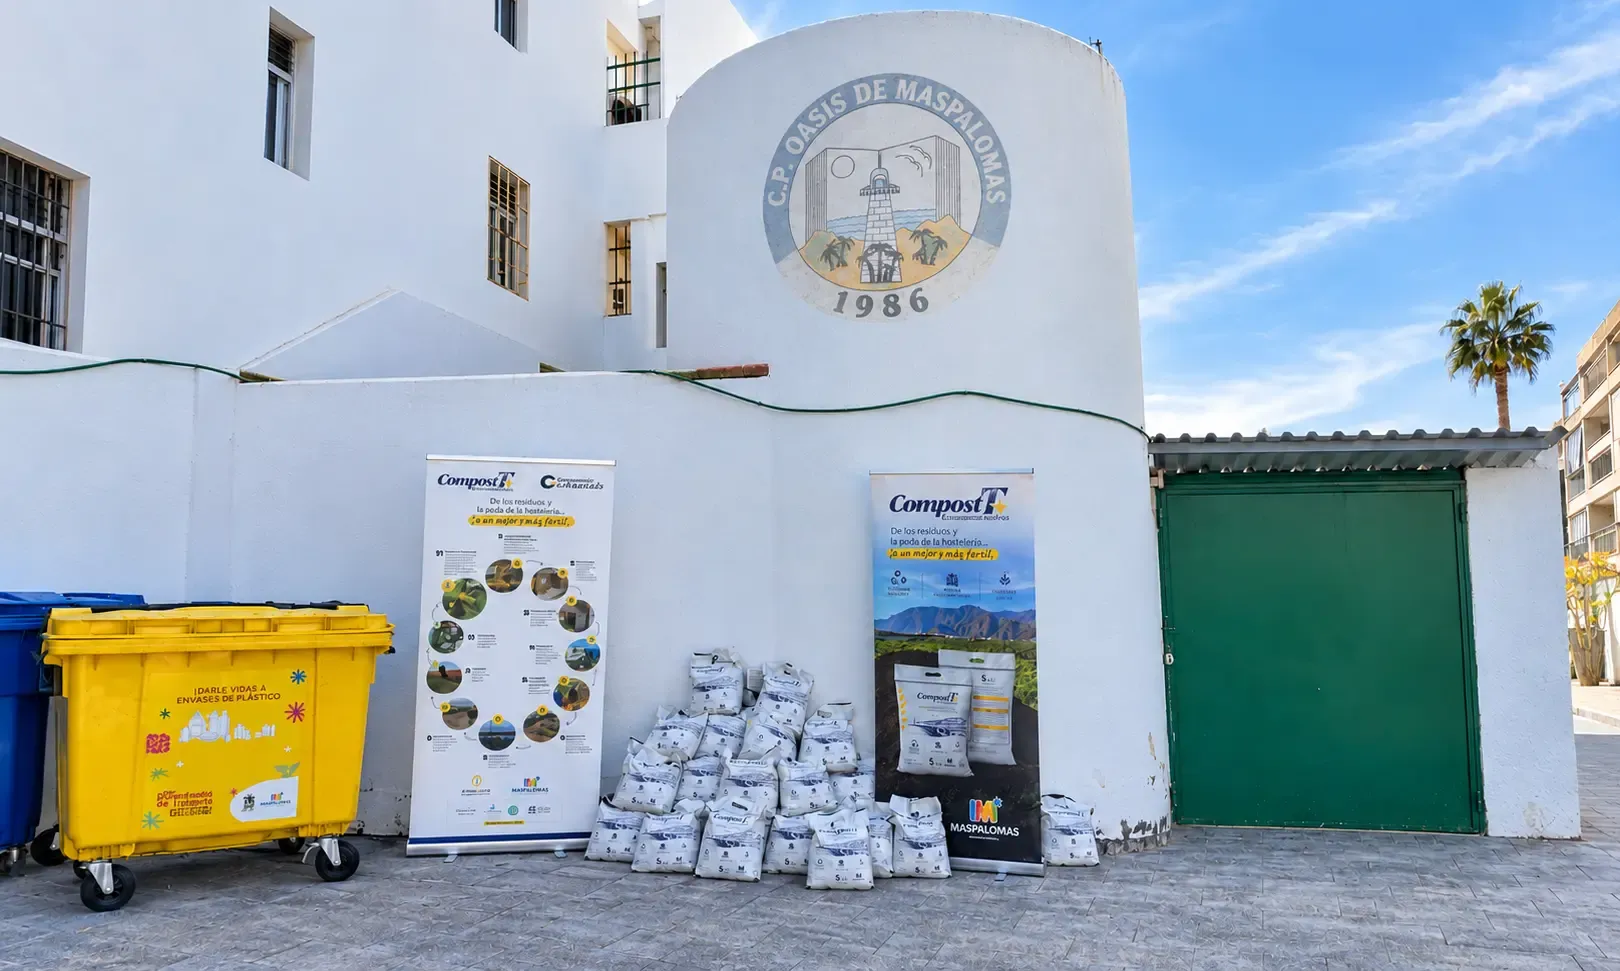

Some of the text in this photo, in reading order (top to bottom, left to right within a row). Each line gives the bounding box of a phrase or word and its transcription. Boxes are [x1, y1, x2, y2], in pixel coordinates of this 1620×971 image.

[767, 79, 1006, 207] C.P. OASIS DE MASPALOMAS
[832, 287, 929, 318] 1986
[547, 500, 553, 508] y
[505, 506, 515, 514] de
[890, 527, 958, 537] De los residuos y
[890, 537, 898, 545] la
[921, 537, 931, 546] de
[933, 537, 940, 546] la
[938, 551, 943, 559] y
[230, 685, 257, 693] VIDAS
[177, 695, 220, 705] ENVASES
[222, 694, 234, 703] DE
[950, 822, 1020, 837] MASPALOMAS
